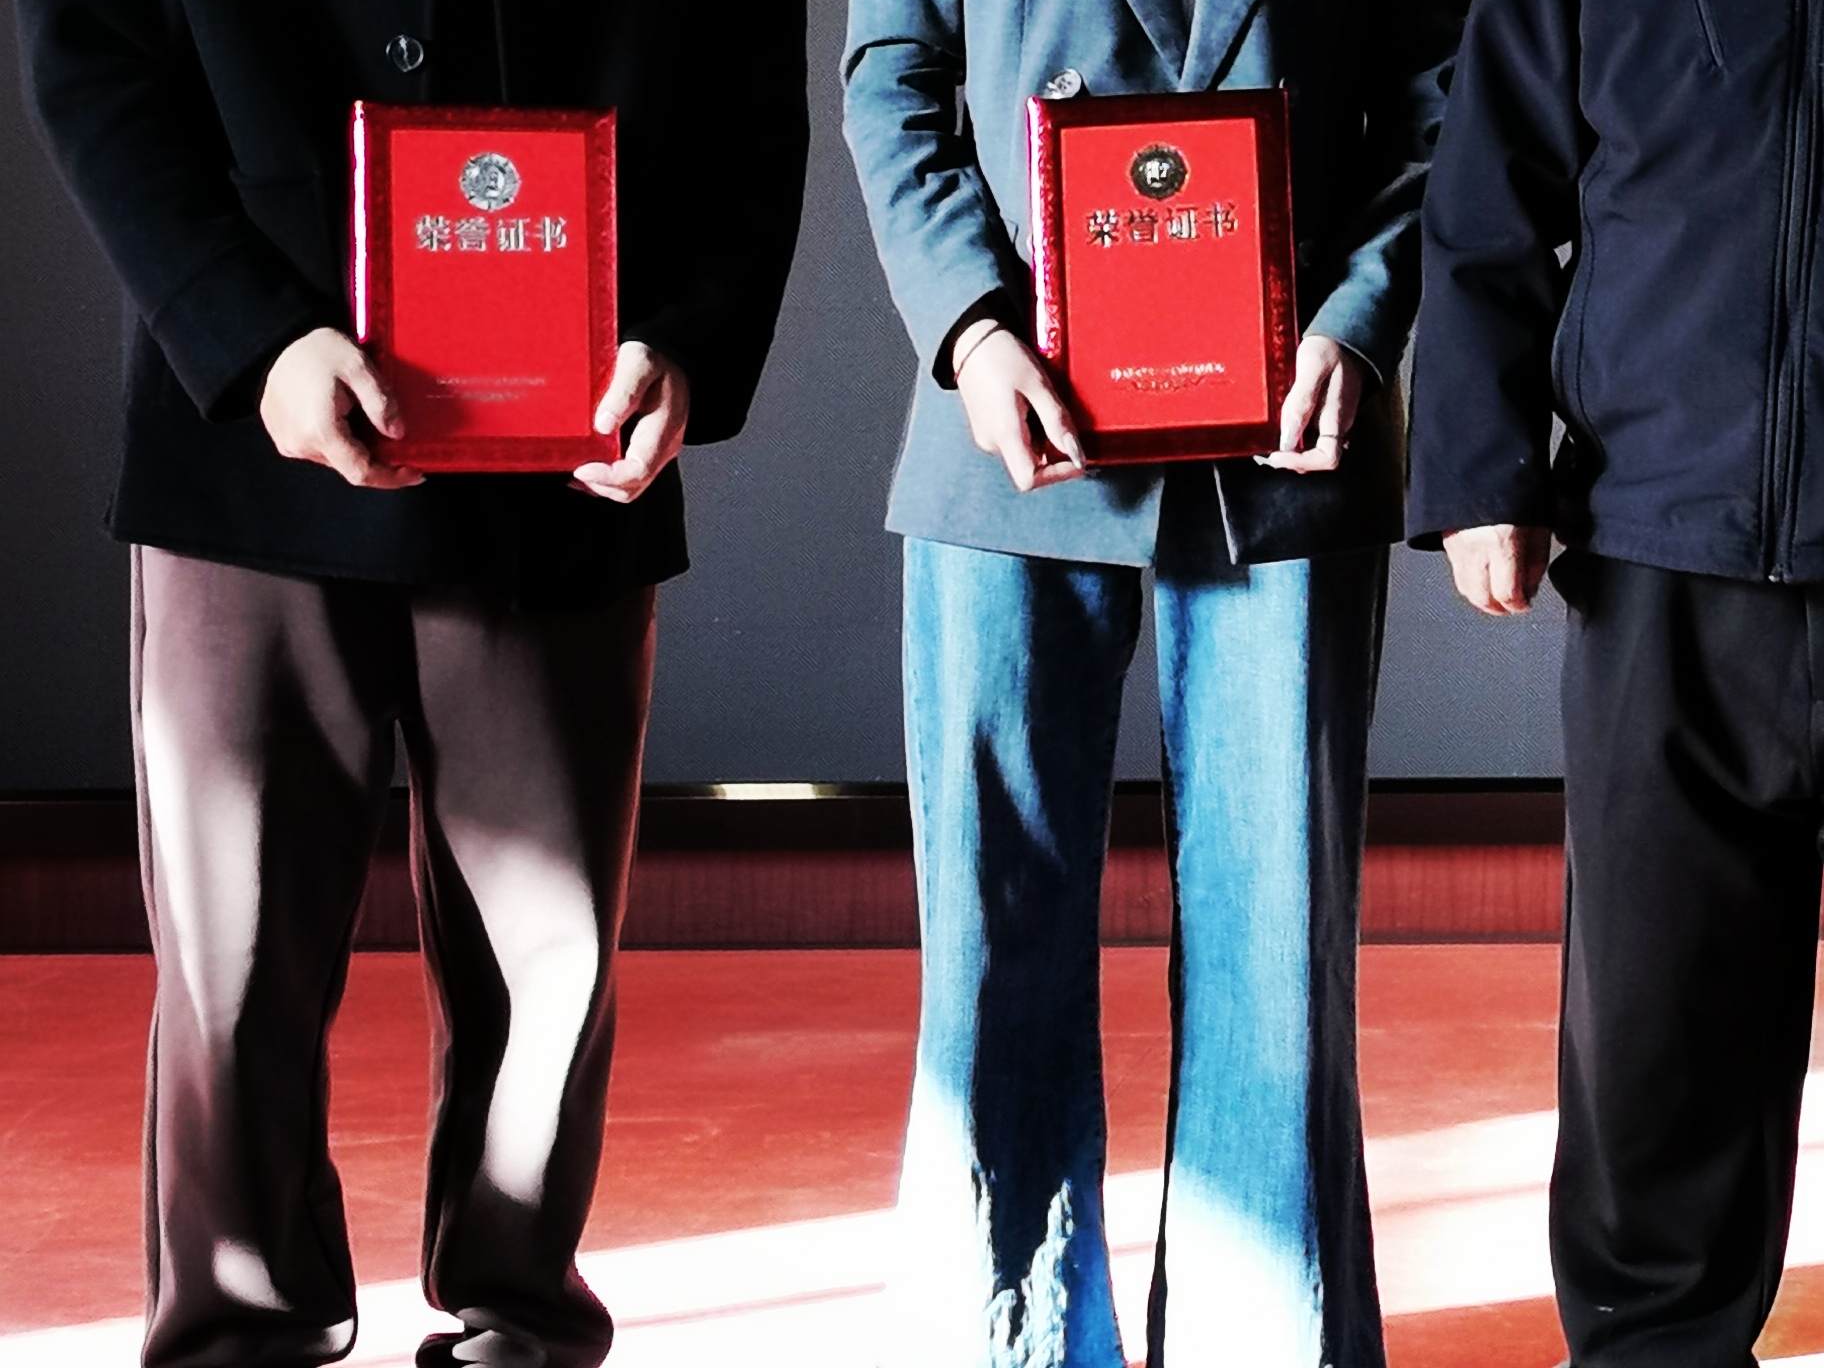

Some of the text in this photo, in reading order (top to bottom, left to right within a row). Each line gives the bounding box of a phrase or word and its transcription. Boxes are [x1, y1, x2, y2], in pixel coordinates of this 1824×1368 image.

[414, 214, 568, 253] 荣誉证书
[1085, 201, 1238, 248] 荣誉证书
